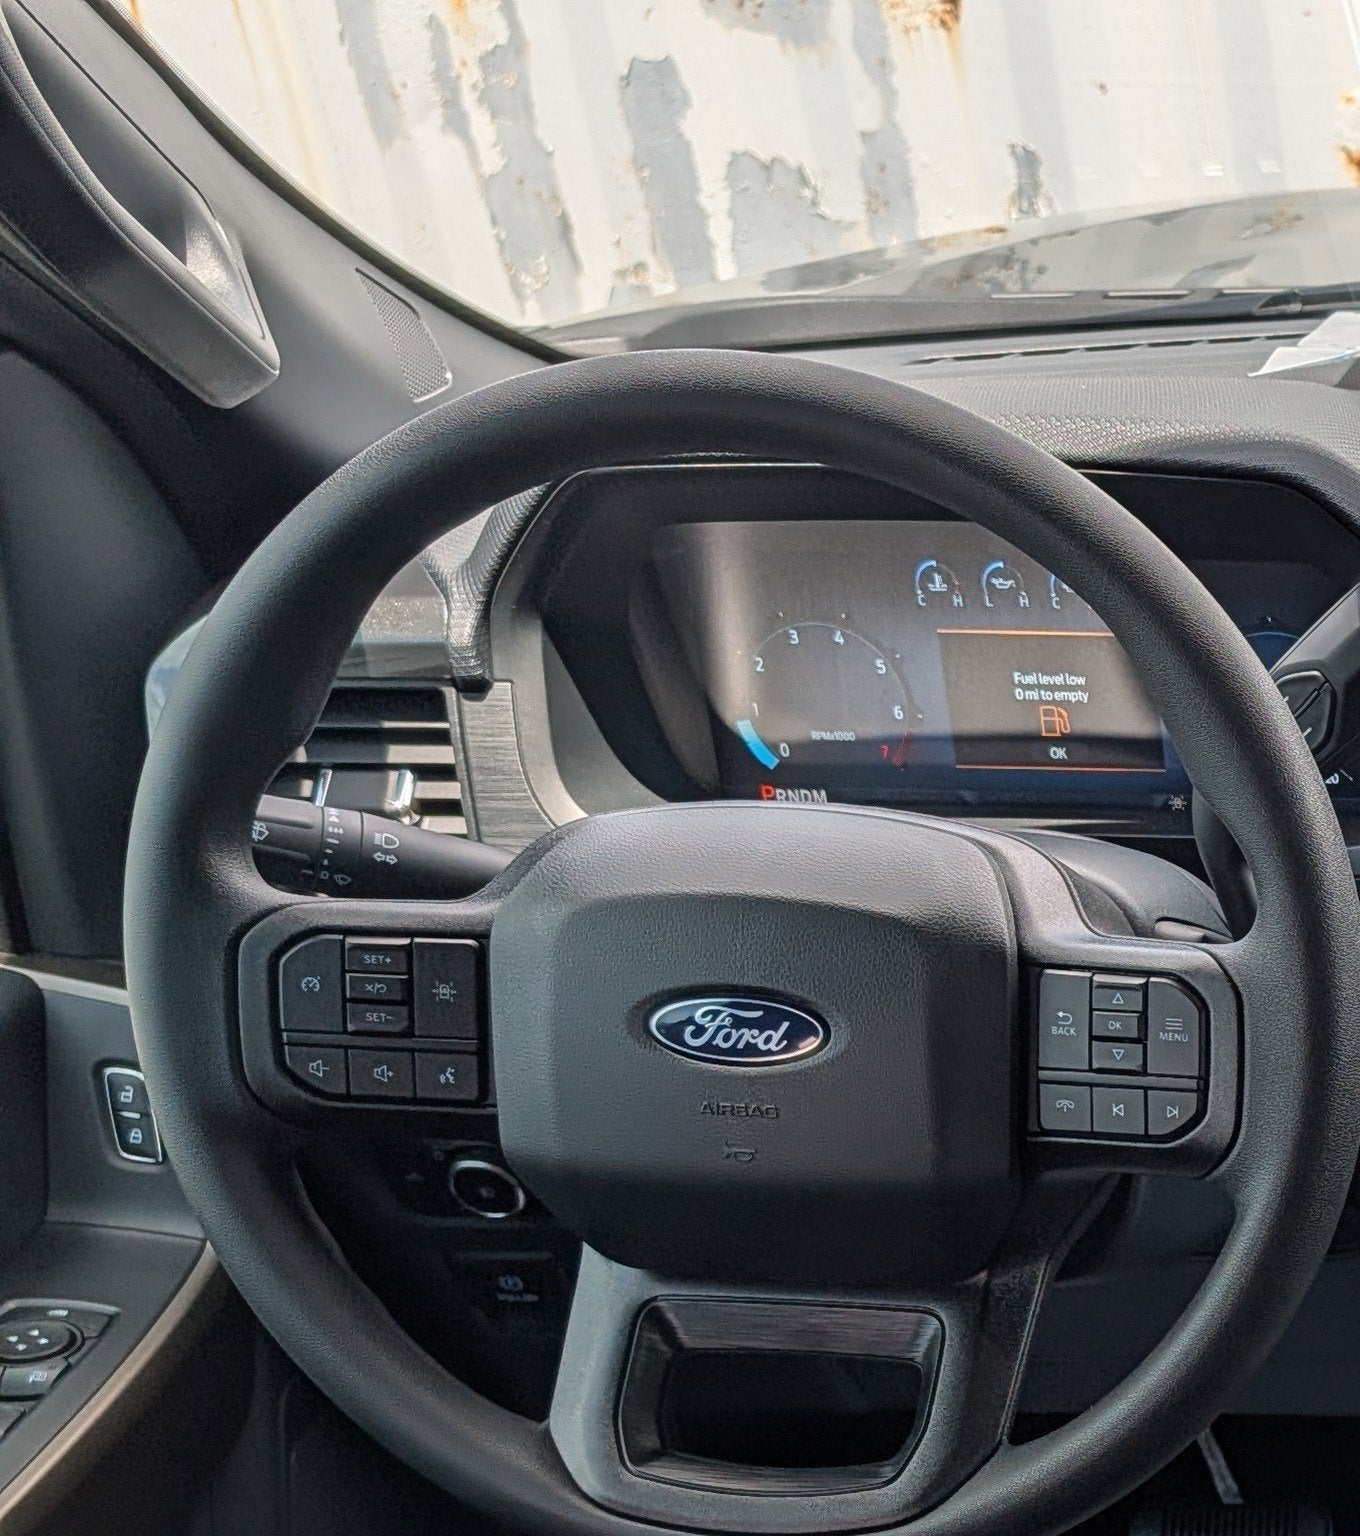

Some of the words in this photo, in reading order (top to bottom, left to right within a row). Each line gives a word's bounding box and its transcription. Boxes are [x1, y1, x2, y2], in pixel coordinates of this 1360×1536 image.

[788, 629, 799, 645] 3
[833, 630, 845, 646] 4
[755, 657, 765, 672] 2
[875, 659, 887, 674] 5
[1013, 671, 1037, 685] Fuel
[1038, 672, 1064, 685] level
[1065, 673, 1086, 686] low
[1040, 690, 1052, 701] to
[1054, 690, 1089, 703] empty
[752, 702, 759, 717] 1
[894, 705, 904, 720] 6
[779, 743, 790, 758] 0
[880, 744, 890, 759] 7
[1049, 747, 1068, 759] OK
[683, 1006, 789, 1054] Ford
[1051, 1026, 1077, 1036] BACK
[1108, 1021, 1122, 1030] OK
[1159, 1032, 1189, 1042] MENU
